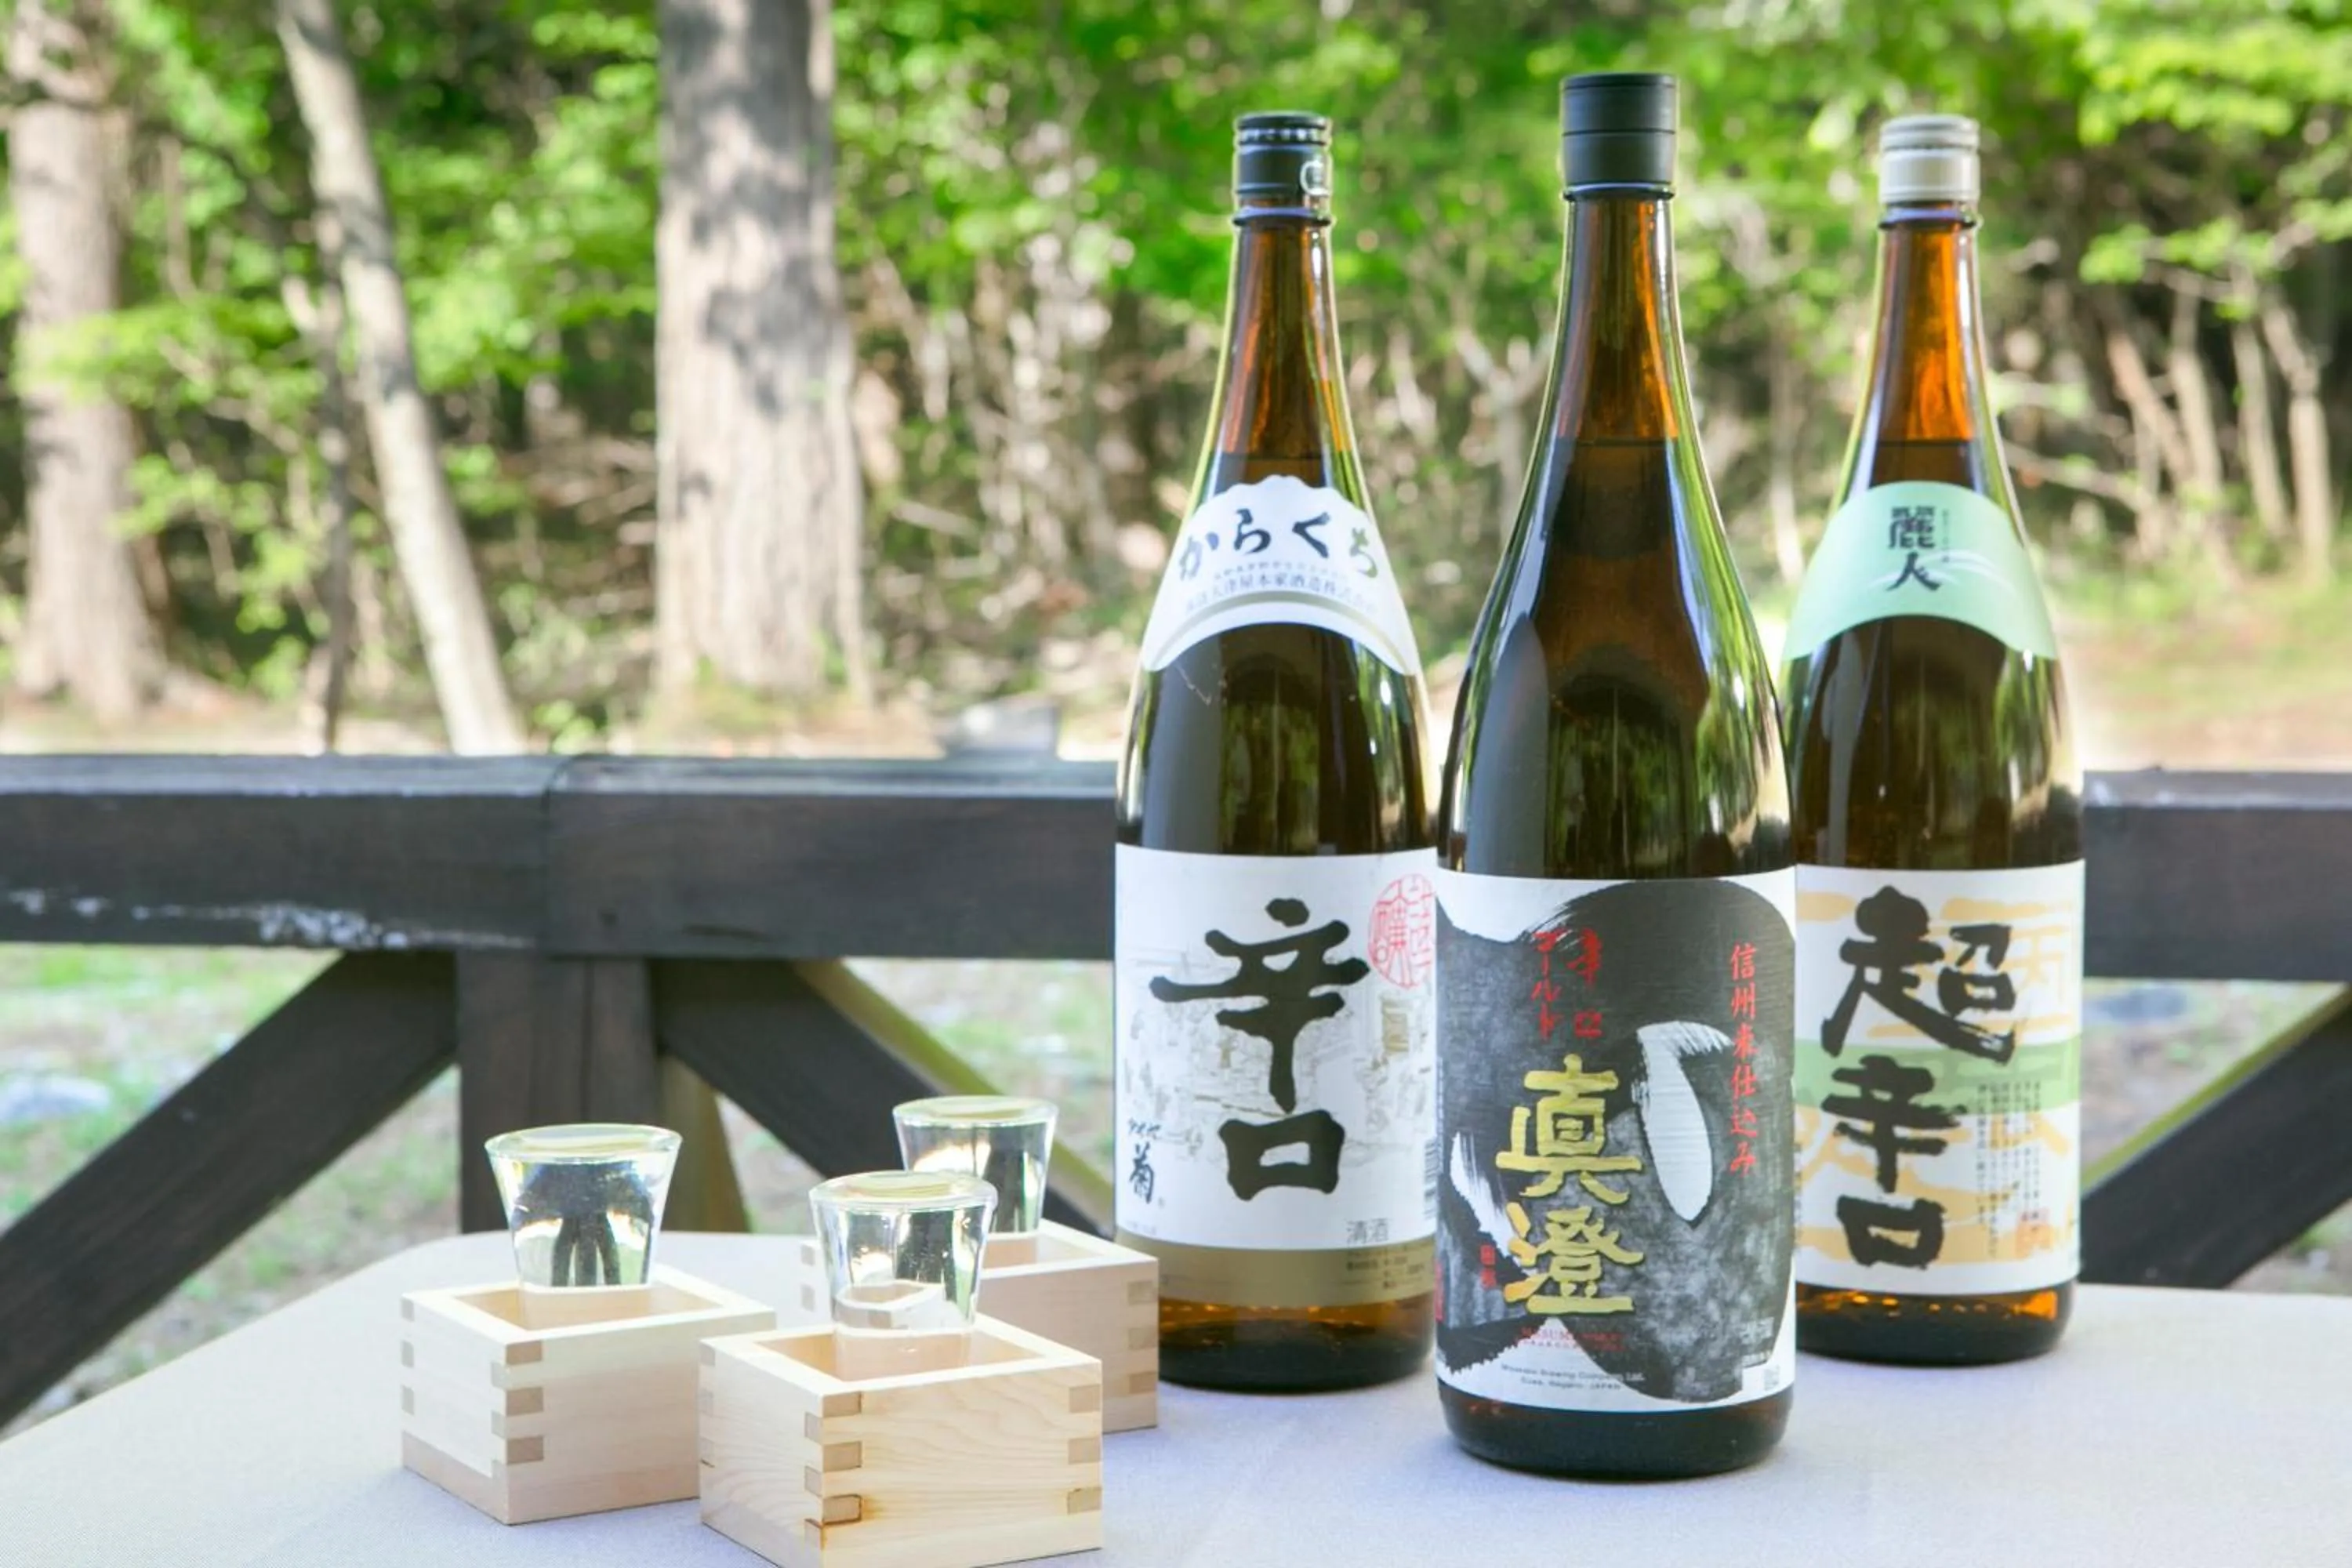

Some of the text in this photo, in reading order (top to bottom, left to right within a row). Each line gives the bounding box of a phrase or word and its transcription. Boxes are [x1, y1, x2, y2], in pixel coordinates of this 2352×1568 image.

[1179, 509, 1378, 579] からくち
[1886, 506, 1941, 591] 麗人
[1567, 927, 1603, 1038] 辛口
[1149, 898, 1370, 1201] 辛口
[1730, 943, 1757, 1176] 信州米仕込み
[1820, 885, 2019, 1269] 超辛口
[1345, 1218, 1389, 1245] 清酒
